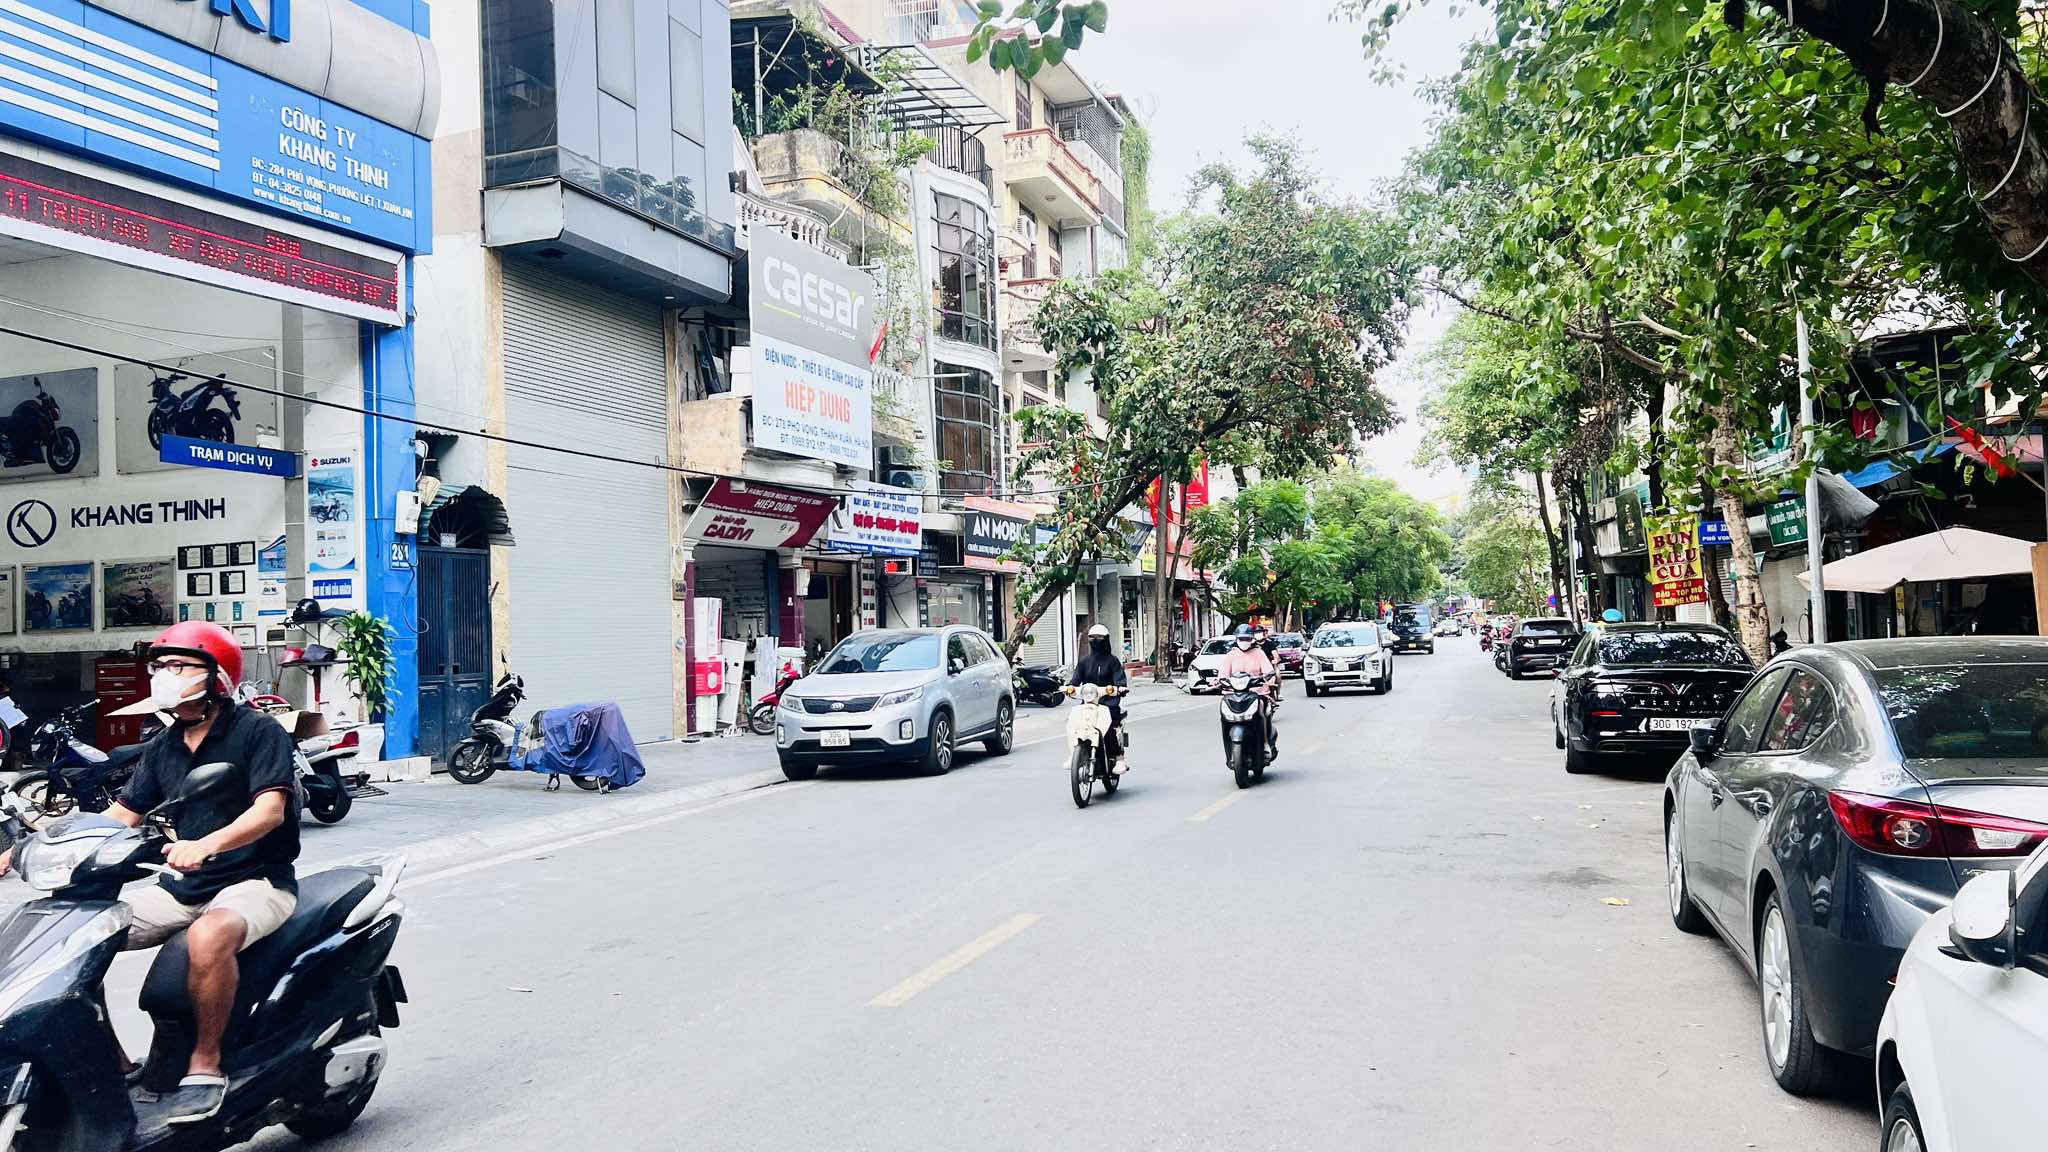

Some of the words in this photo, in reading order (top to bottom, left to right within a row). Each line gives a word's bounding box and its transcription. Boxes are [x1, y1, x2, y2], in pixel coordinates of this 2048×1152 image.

[281, 105, 327, 141] CÔNG
[334, 126, 357, 150] TY
[279, 133, 337, 172] KHANG
[344, 156, 389, 190] THỊNH
[784, 379, 816, 418] HIỆP
[820, 390, 851, 424] DUNG
[190, 446, 224, 463] TRẠM
[227, 450, 255, 466] DỊCH
[257, 454, 273, 470] VỤ
[320, 458, 350, 466] SUZUKI
[71, 504, 153, 528] KHANG
[159, 497, 225, 522] THINH
[973, 515, 990, 538] AN
[1656, 564, 1697, 579] CUA
[1653, 719, 1671, 729] 30G
